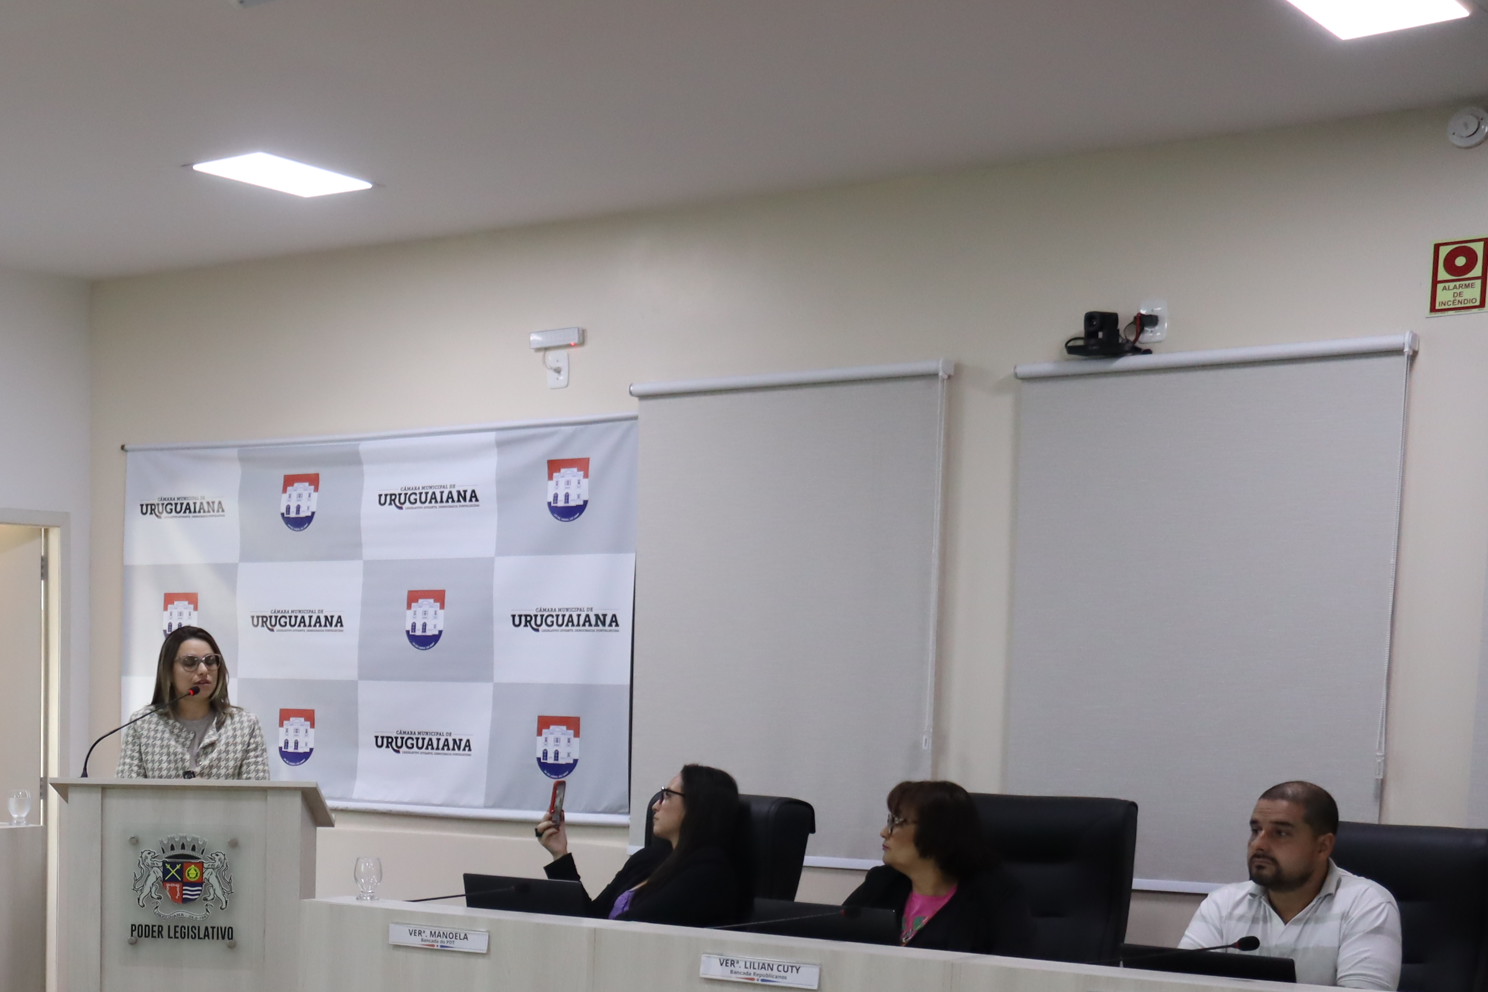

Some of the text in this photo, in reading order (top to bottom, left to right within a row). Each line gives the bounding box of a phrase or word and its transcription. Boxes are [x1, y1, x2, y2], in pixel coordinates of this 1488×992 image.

[1442, 282, 1476, 291] ALARME
[1438, 297, 1478, 307] INCÊNDIO
[378, 489, 480, 510] URUGUAIANA
[140, 500, 225, 519] URUGUAIANA
[251, 614, 344, 632] URUGUAIANA
[511, 613, 620, 632] URUGUAIANA
[374, 735, 472, 754] URUGUAIANA
[130, 924, 234, 941] PODER LEGISLATIVO
[429, 930, 469, 941] MANOELA
[744, 960, 774, 972] LILIAN
[776, 964, 801, 974] CUTY
